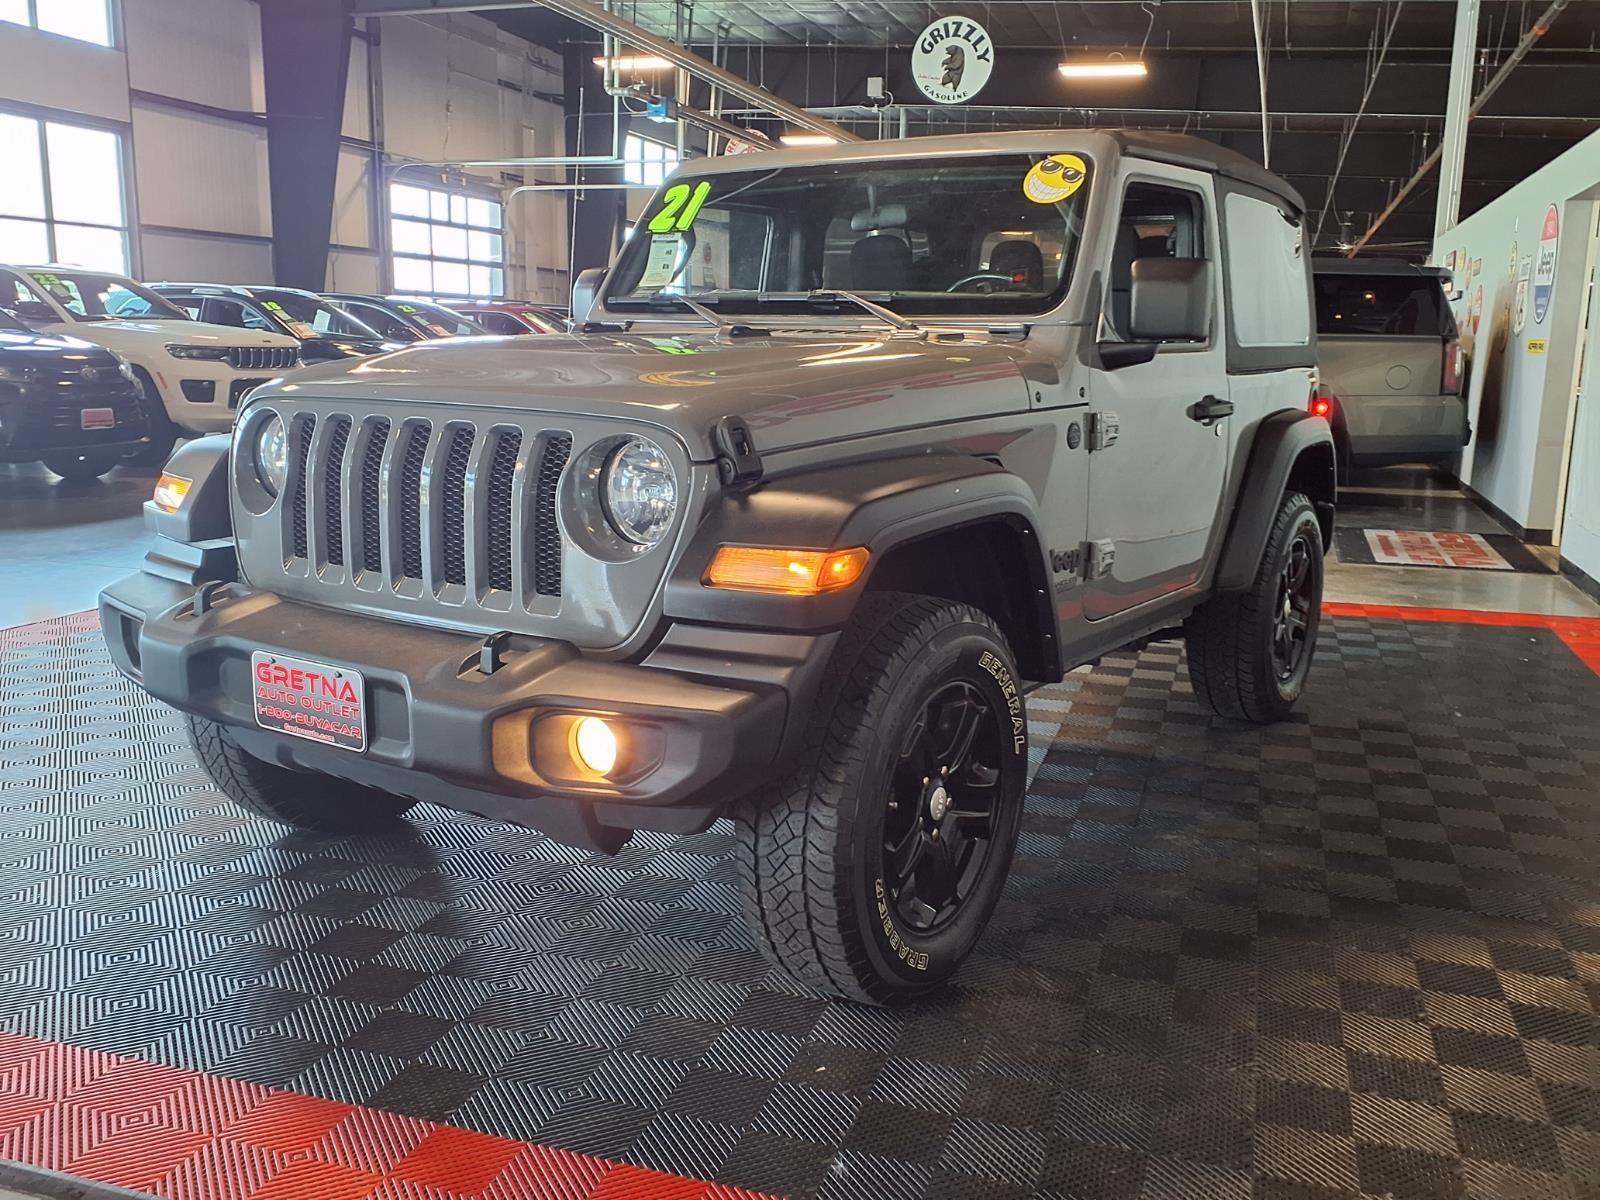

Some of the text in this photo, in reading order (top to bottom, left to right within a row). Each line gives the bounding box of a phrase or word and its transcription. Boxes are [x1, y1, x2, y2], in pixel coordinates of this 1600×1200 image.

[921, 21, 990, 63] GRIZZLY
[924, 85, 968, 101] GASOLINE
[648, 181, 712, 233] 21
[33, 274, 61, 285] 23
[256, 662, 358, 703] GRETNA
[257, 686, 360, 720] AUTO OUTLET
[978, 651, 1025, 754] GENERAL
[257, 703, 362, 739] 1-800-BUYACAR
[875, 879, 928, 970] GRABBER
